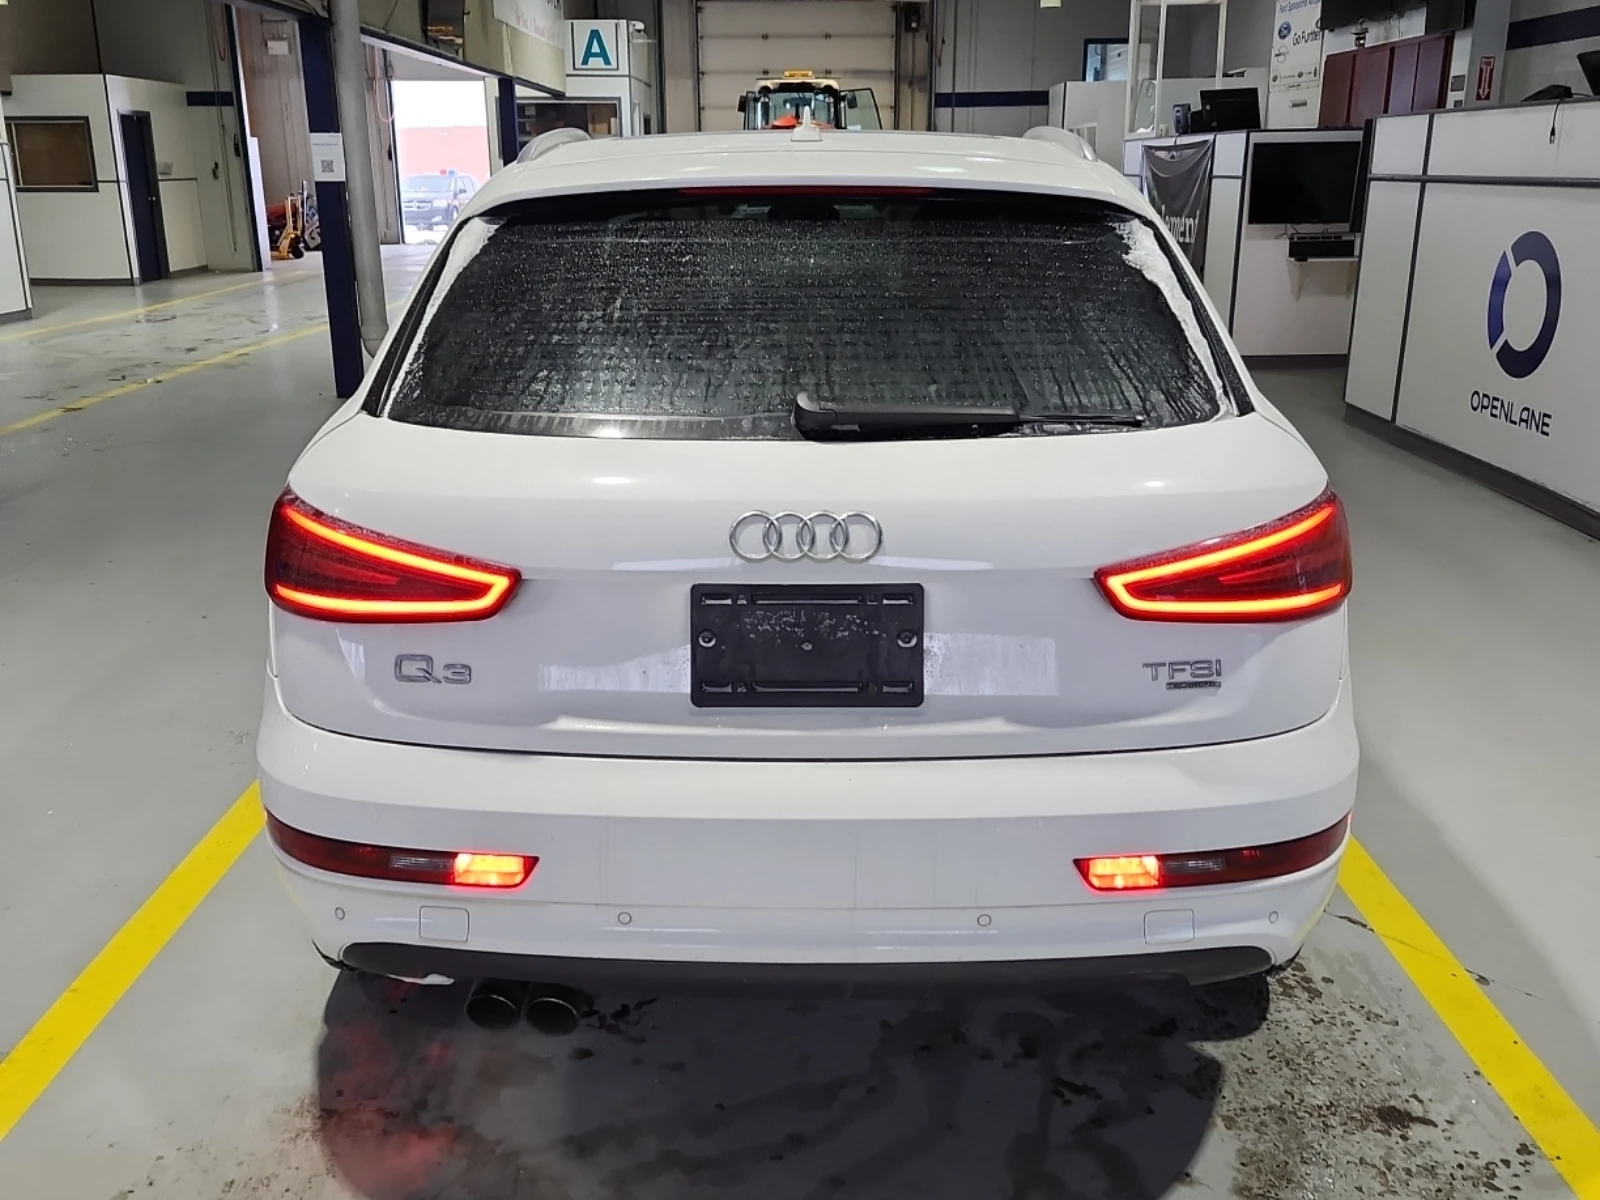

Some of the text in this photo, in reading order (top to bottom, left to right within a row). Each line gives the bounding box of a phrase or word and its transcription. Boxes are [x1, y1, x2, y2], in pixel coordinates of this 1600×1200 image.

[581, 29, 612, 66] A
[1470, 390, 1552, 437] OPENLANE
[394, 653, 472, 685] Q3
[1142, 658, 1222, 681] TFSI
